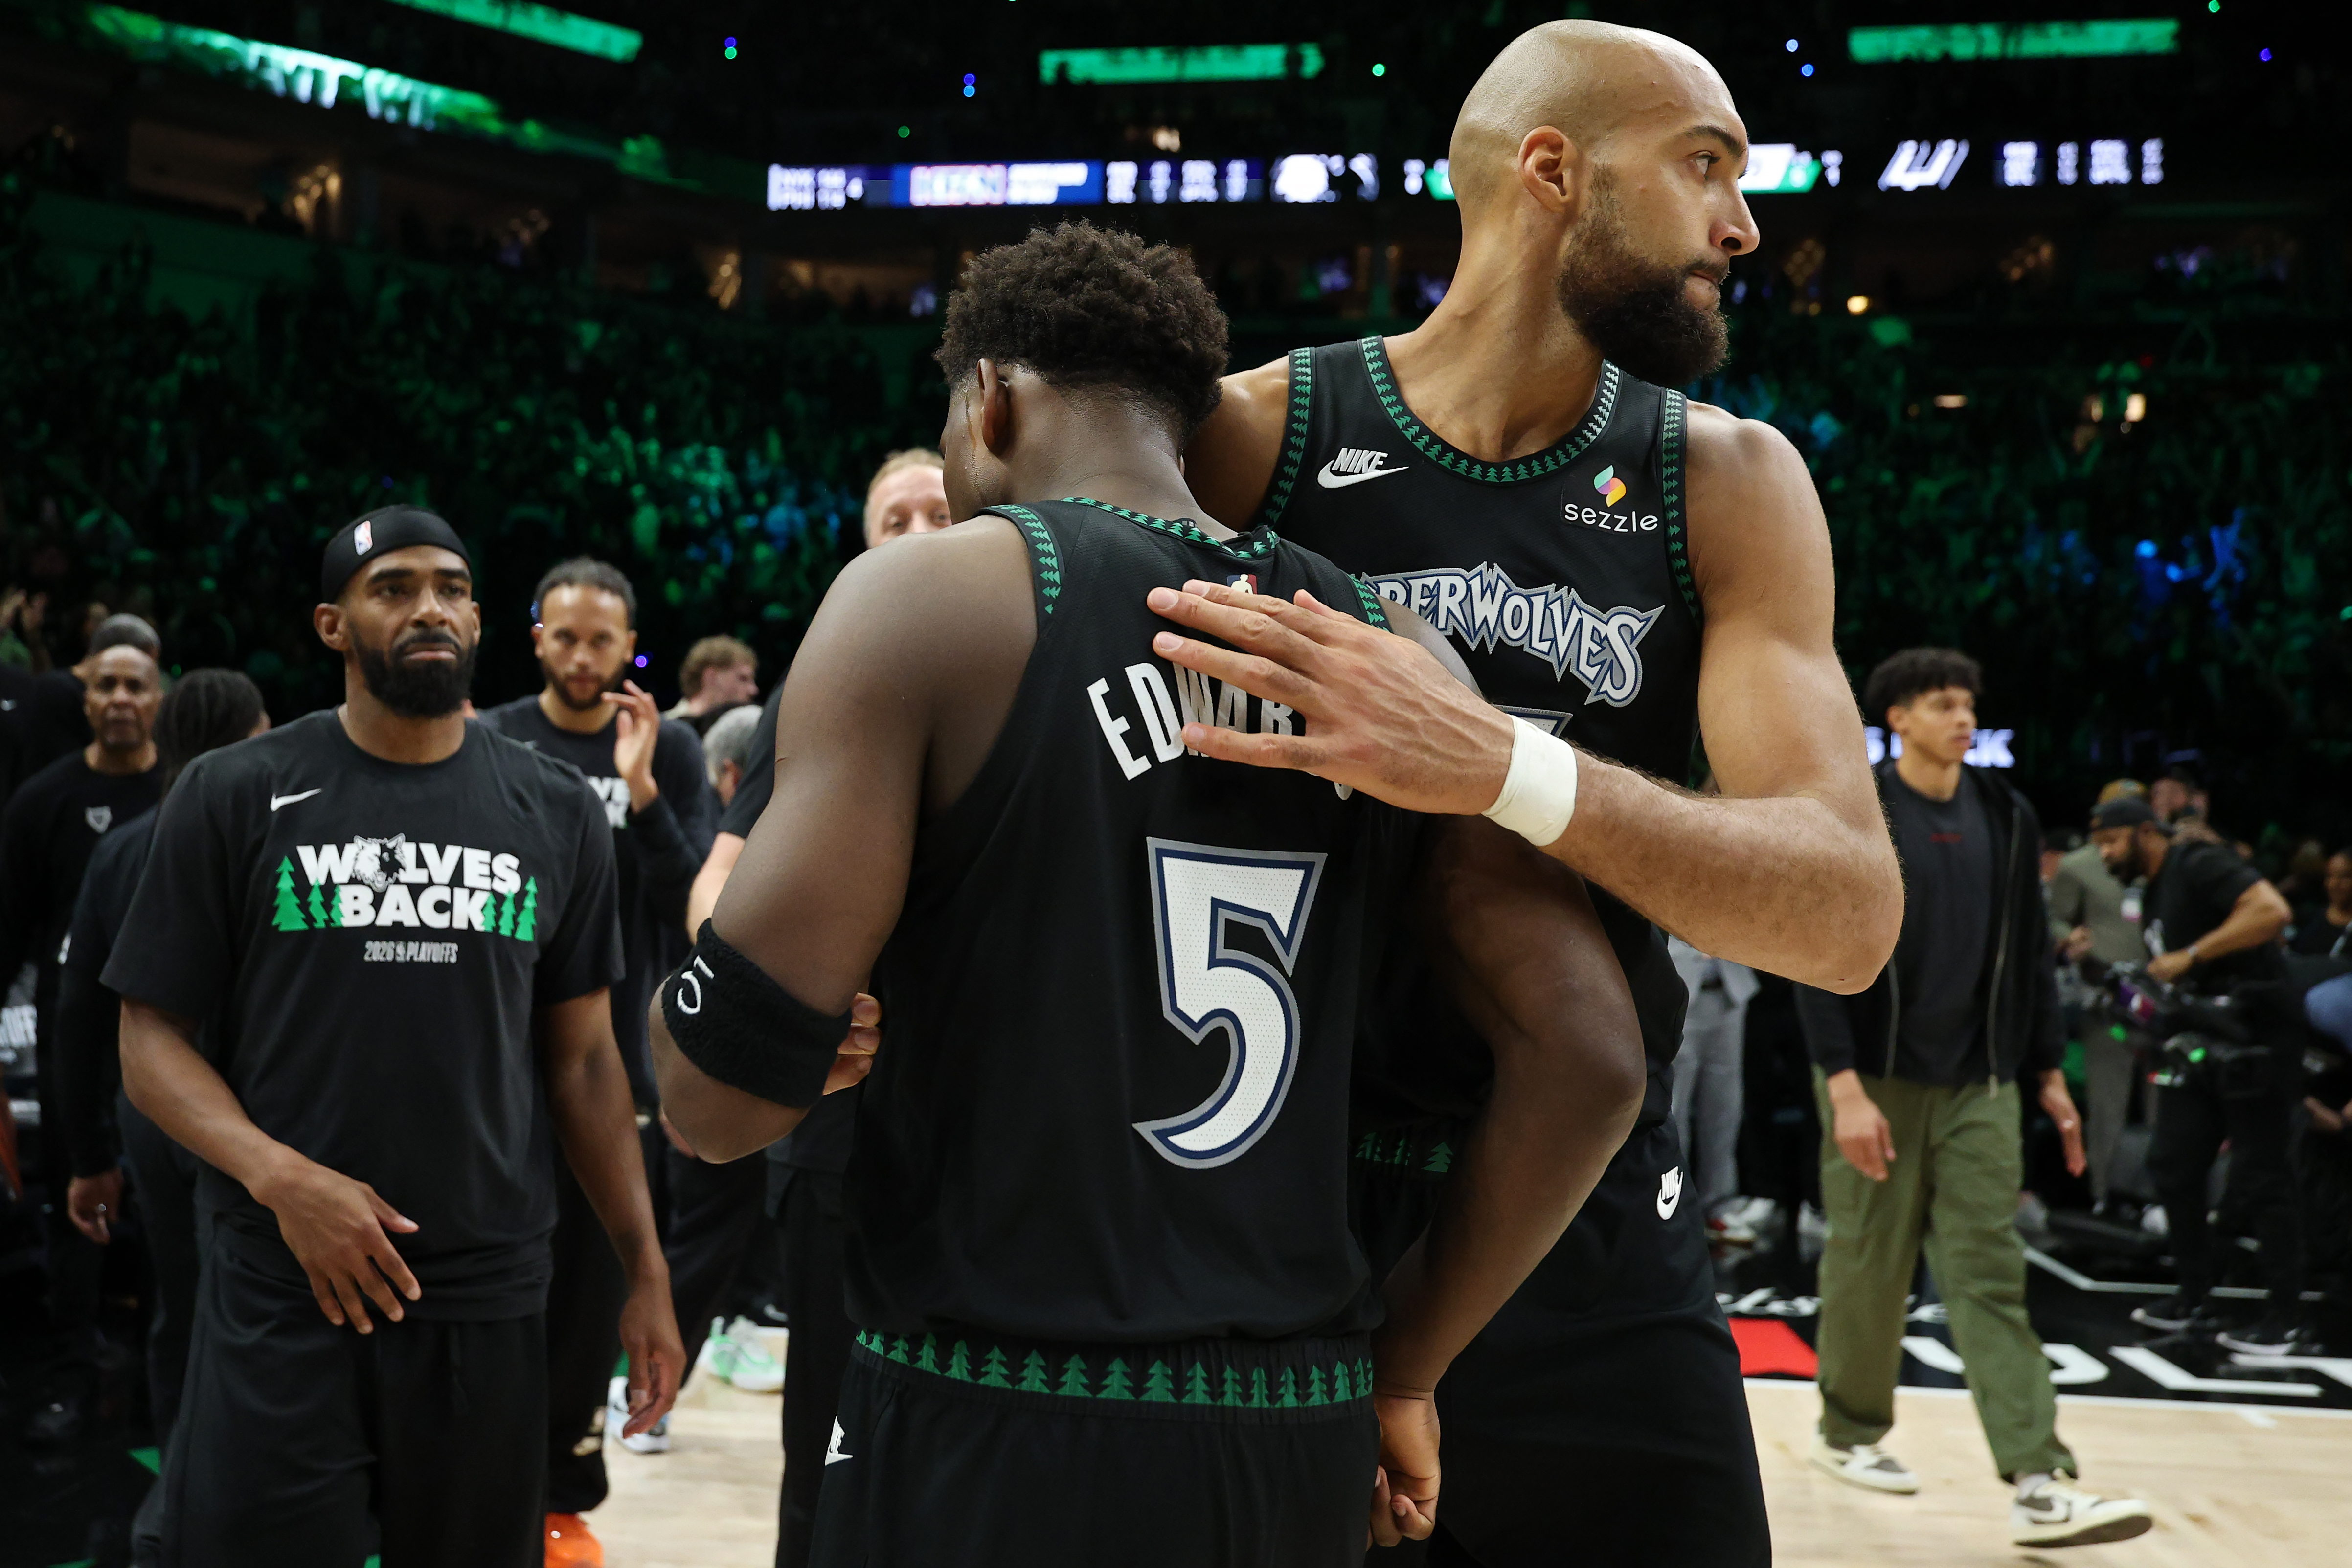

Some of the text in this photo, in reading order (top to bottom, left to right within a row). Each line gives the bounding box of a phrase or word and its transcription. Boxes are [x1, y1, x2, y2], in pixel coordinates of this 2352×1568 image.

[1331, 447, 1388, 473] NIKE
[1564, 503, 1658, 532] sezzle
[1360, 560, 1666, 708] ERWOLVES
[339, 884, 490, 932] BACK
[1131, 836, 1328, 1170] 5
